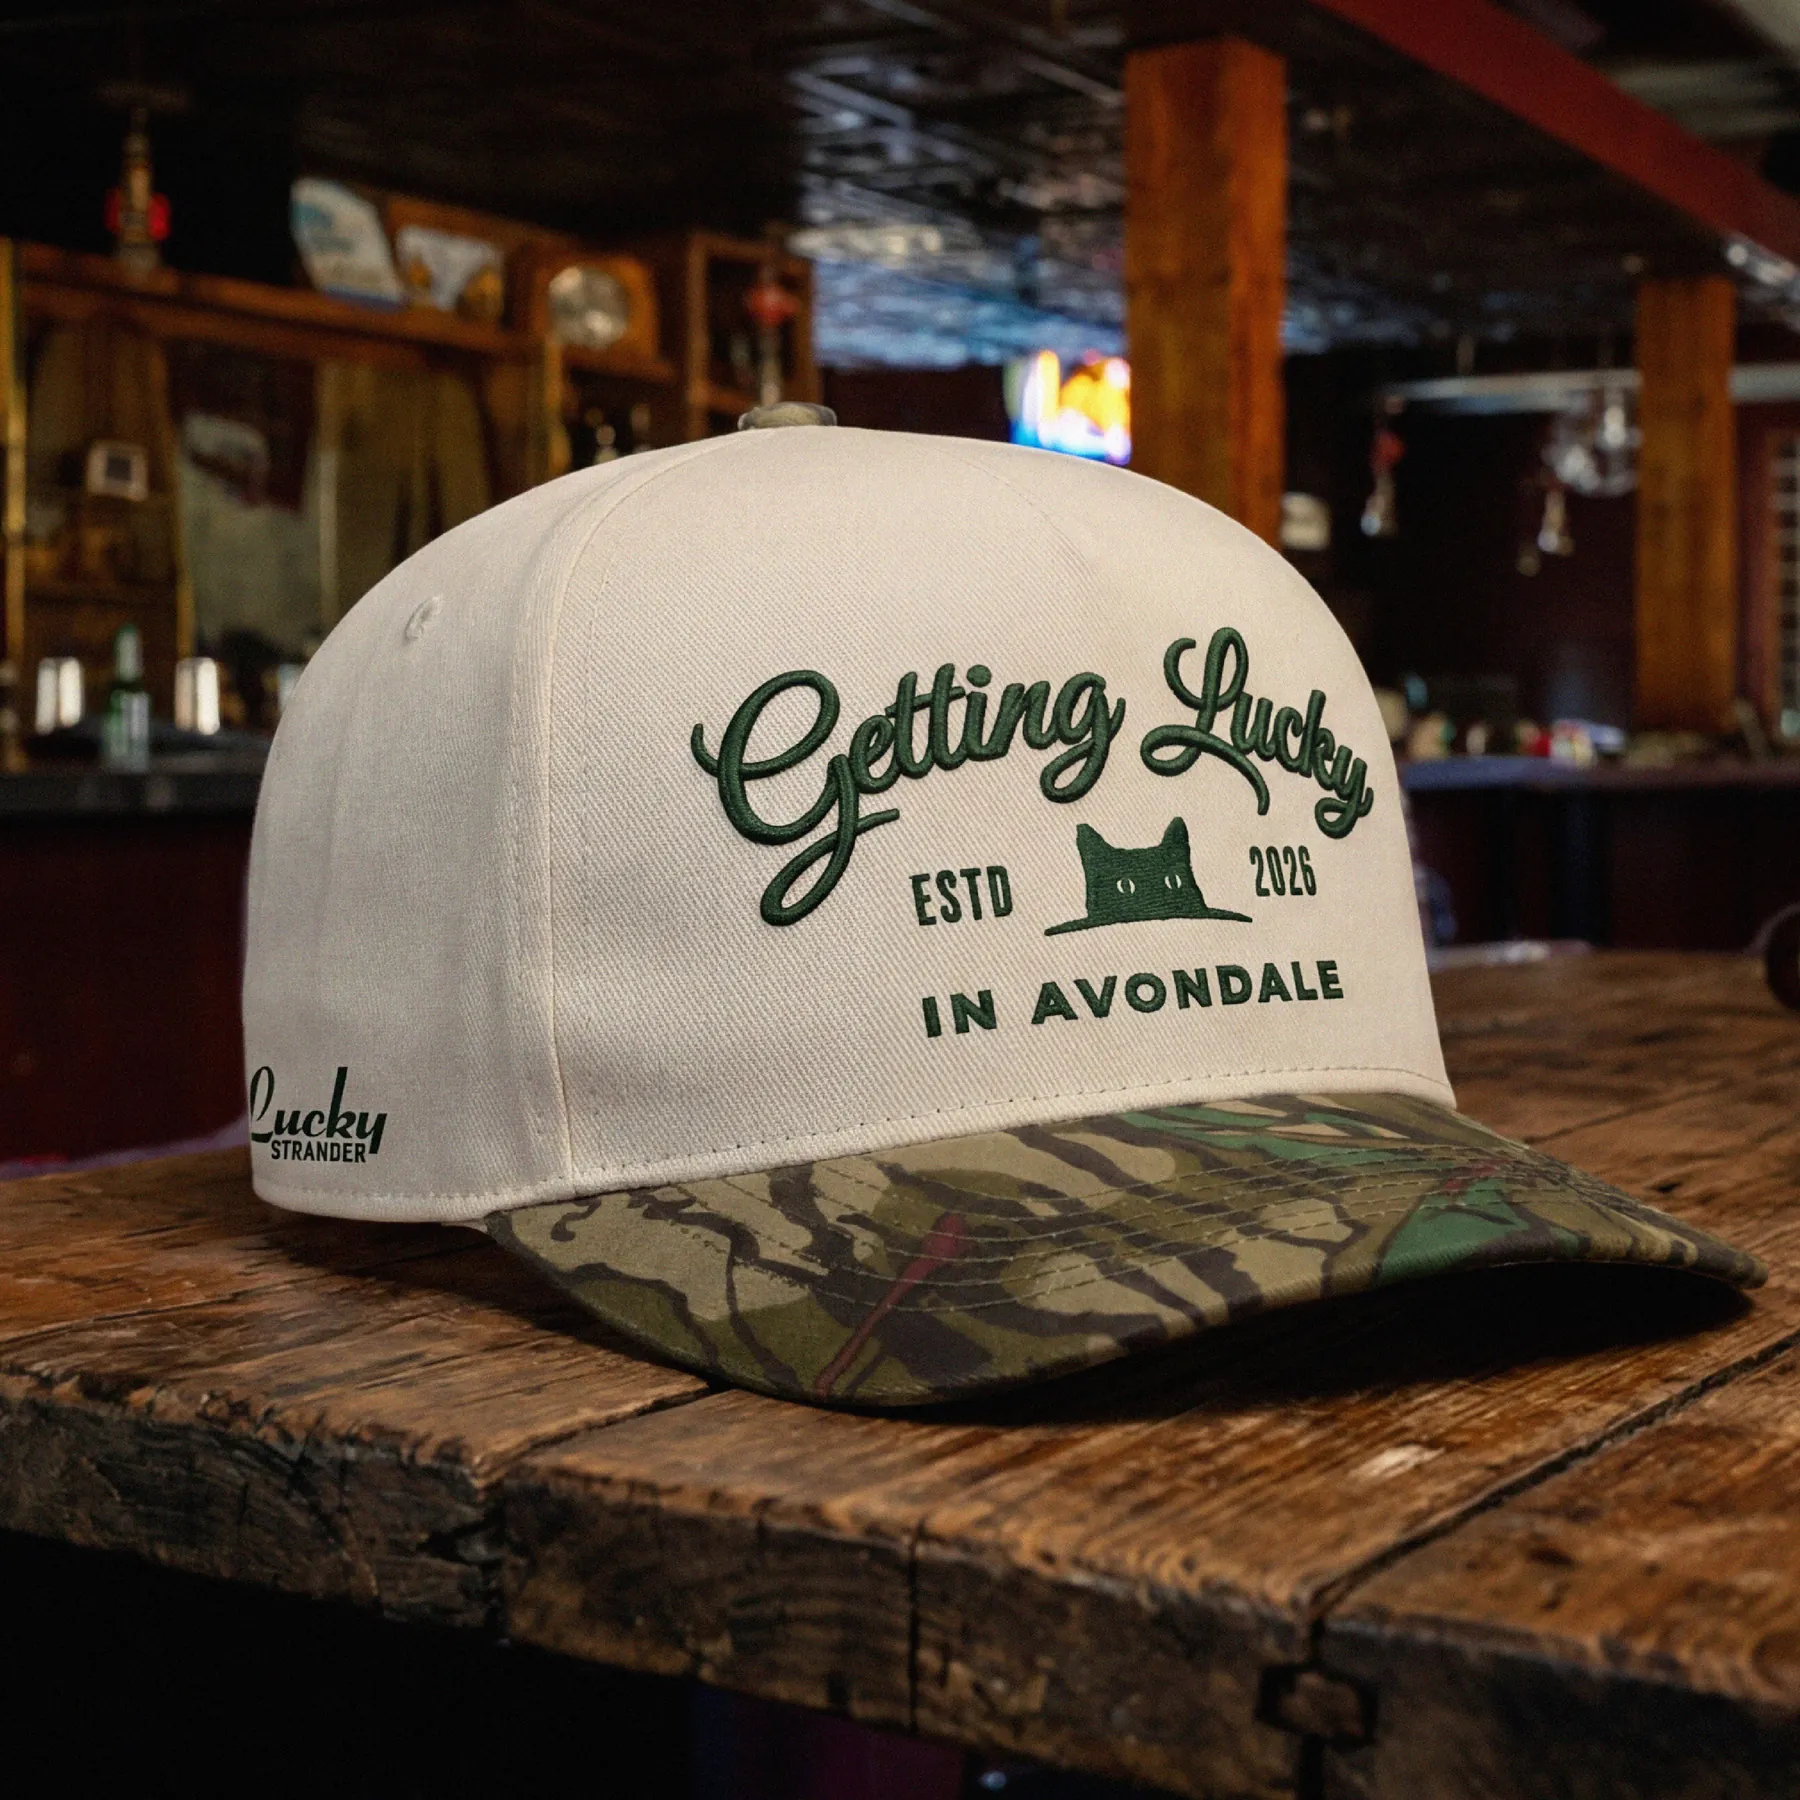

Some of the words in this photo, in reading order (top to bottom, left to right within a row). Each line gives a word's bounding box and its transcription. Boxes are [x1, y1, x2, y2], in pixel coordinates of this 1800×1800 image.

[691, 664, 1125, 926] Getting
[1141, 627, 1373, 838] Lucky
[909, 865, 1013, 926] ESTD
[1249, 846, 1317, 898] 2026
[922, 989, 997, 1038] IN
[1031, 960, 1344, 1024] AVONDALE
[250, 1066, 387, 1154] Lucky
[271, 1140, 366, 1163] STRANDER
